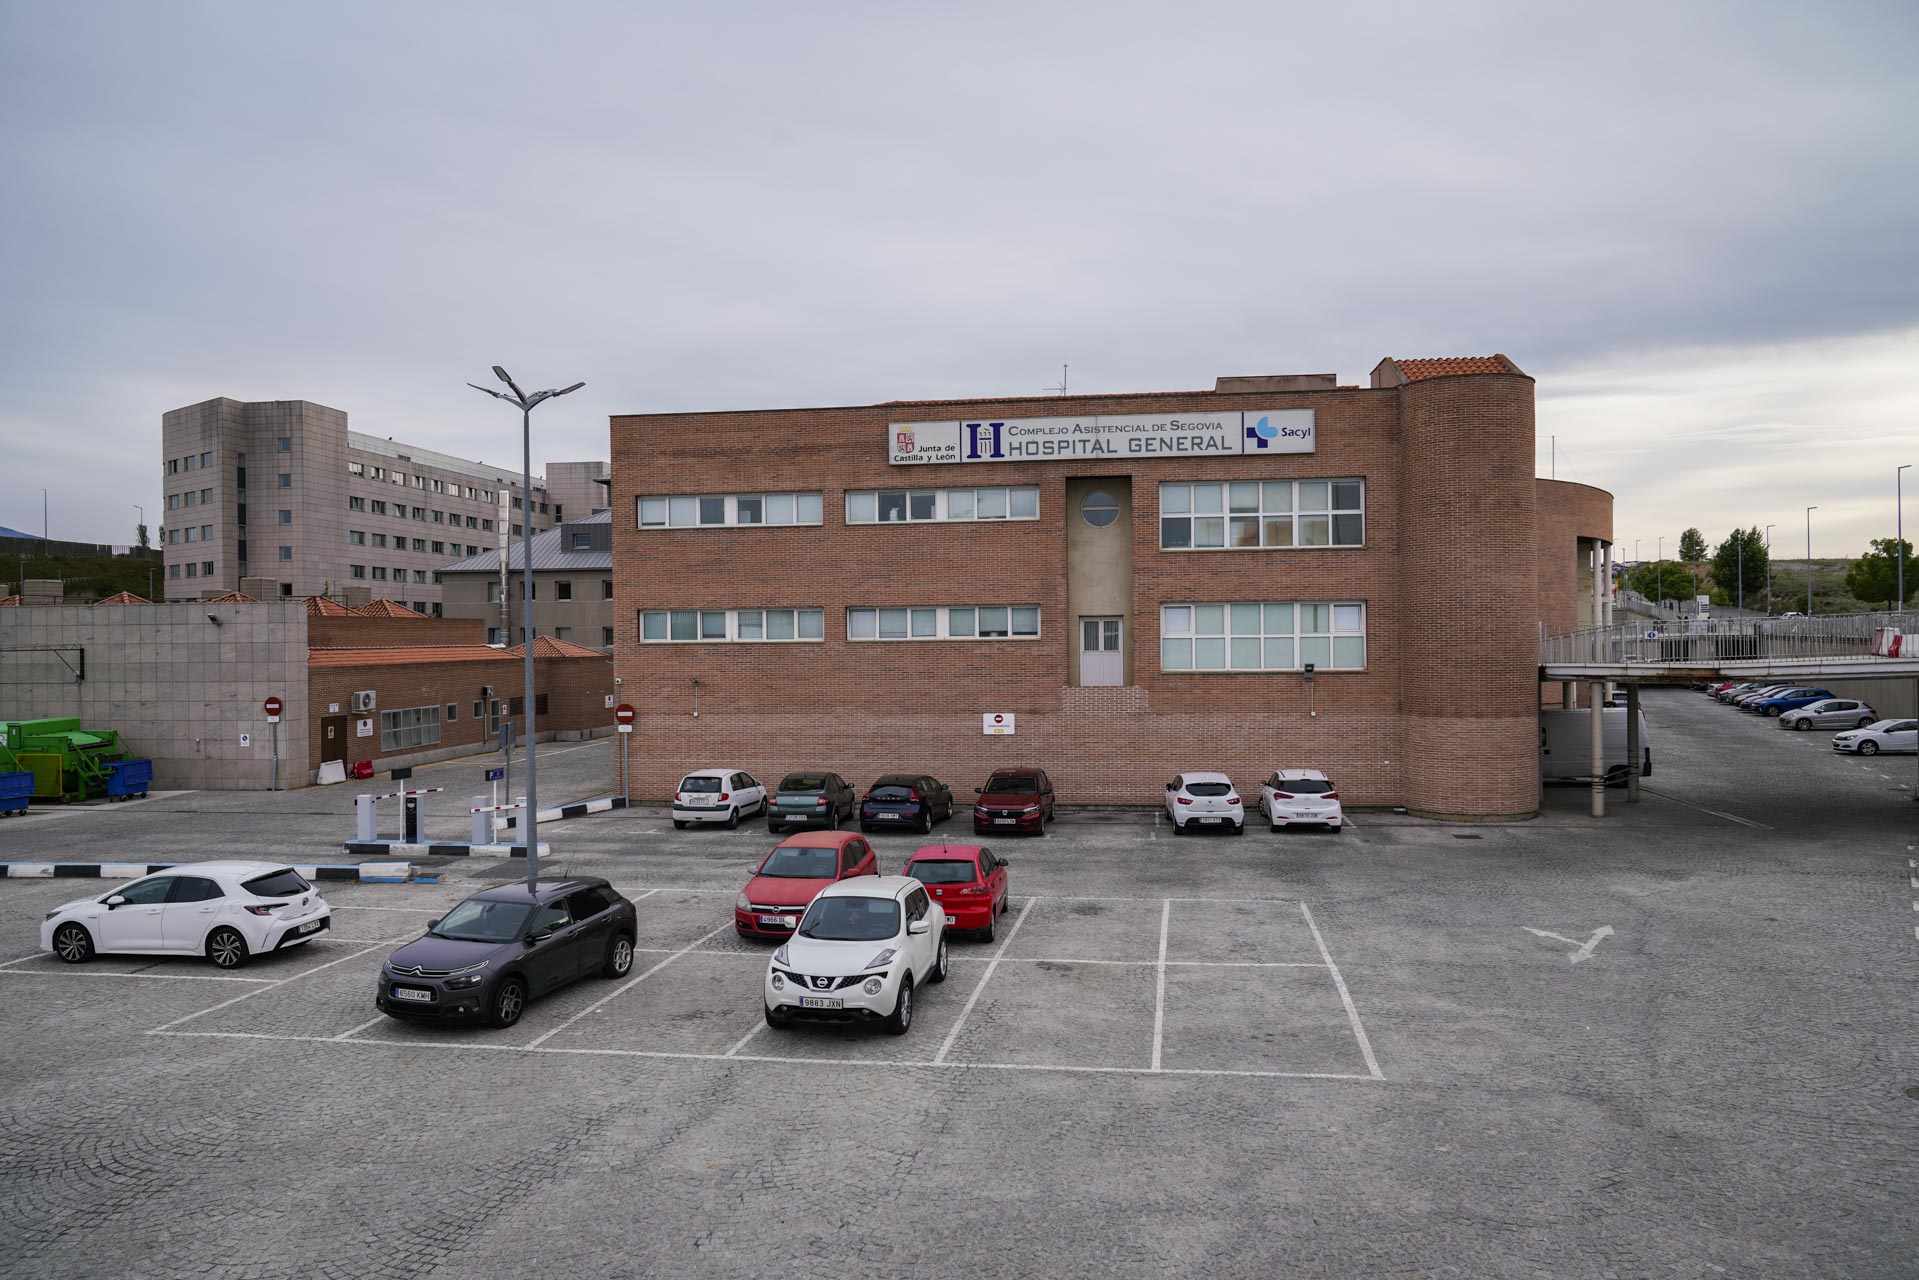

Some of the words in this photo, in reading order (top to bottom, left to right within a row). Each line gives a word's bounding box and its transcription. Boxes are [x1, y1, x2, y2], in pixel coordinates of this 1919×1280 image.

[1008, 426, 1069, 436] COMPLEJO
[1072, 422, 1149, 434] ASISTENCIAL
[1170, 420, 1223, 431] SEGOVIA
[1281, 427, 1311, 439] Sacyl
[1009, 438, 1118, 456] HOSPITAL
[1128, 436, 1233, 453] GENERAL
[894, 454, 923, 462] Castilla
[400, 989, 416, 999] 6560
[804, 998, 824, 1007] 9883
[826, 999, 842, 1009] JXN
